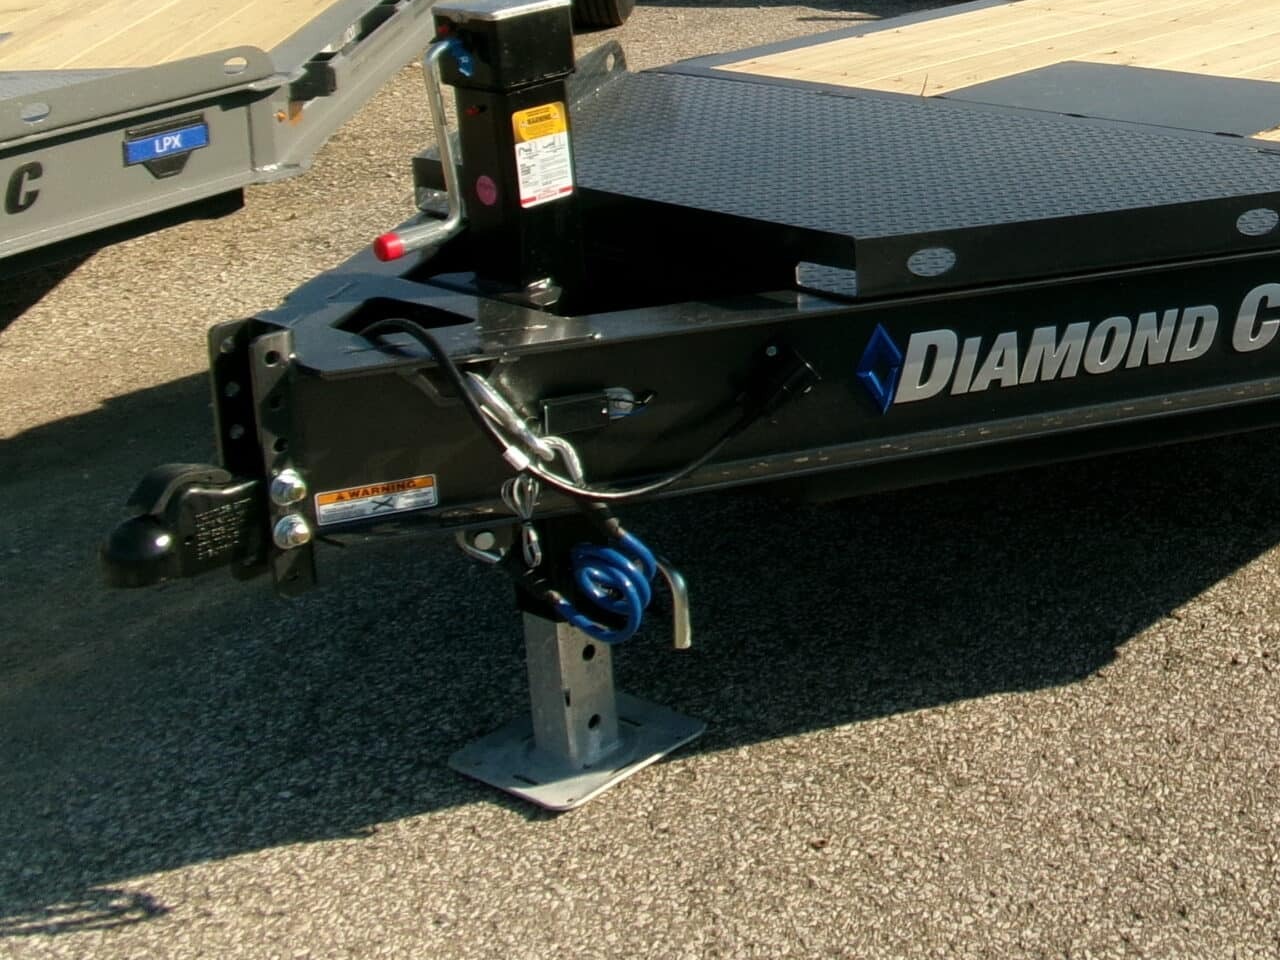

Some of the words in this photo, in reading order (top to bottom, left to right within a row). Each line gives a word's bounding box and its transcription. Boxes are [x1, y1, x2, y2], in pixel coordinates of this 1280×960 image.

[155, 133, 183, 153] LPX
[5, 161, 43, 215] C
[893, 304, 1219, 405] DIAMOND
[348, 480, 416, 498] WARNING
